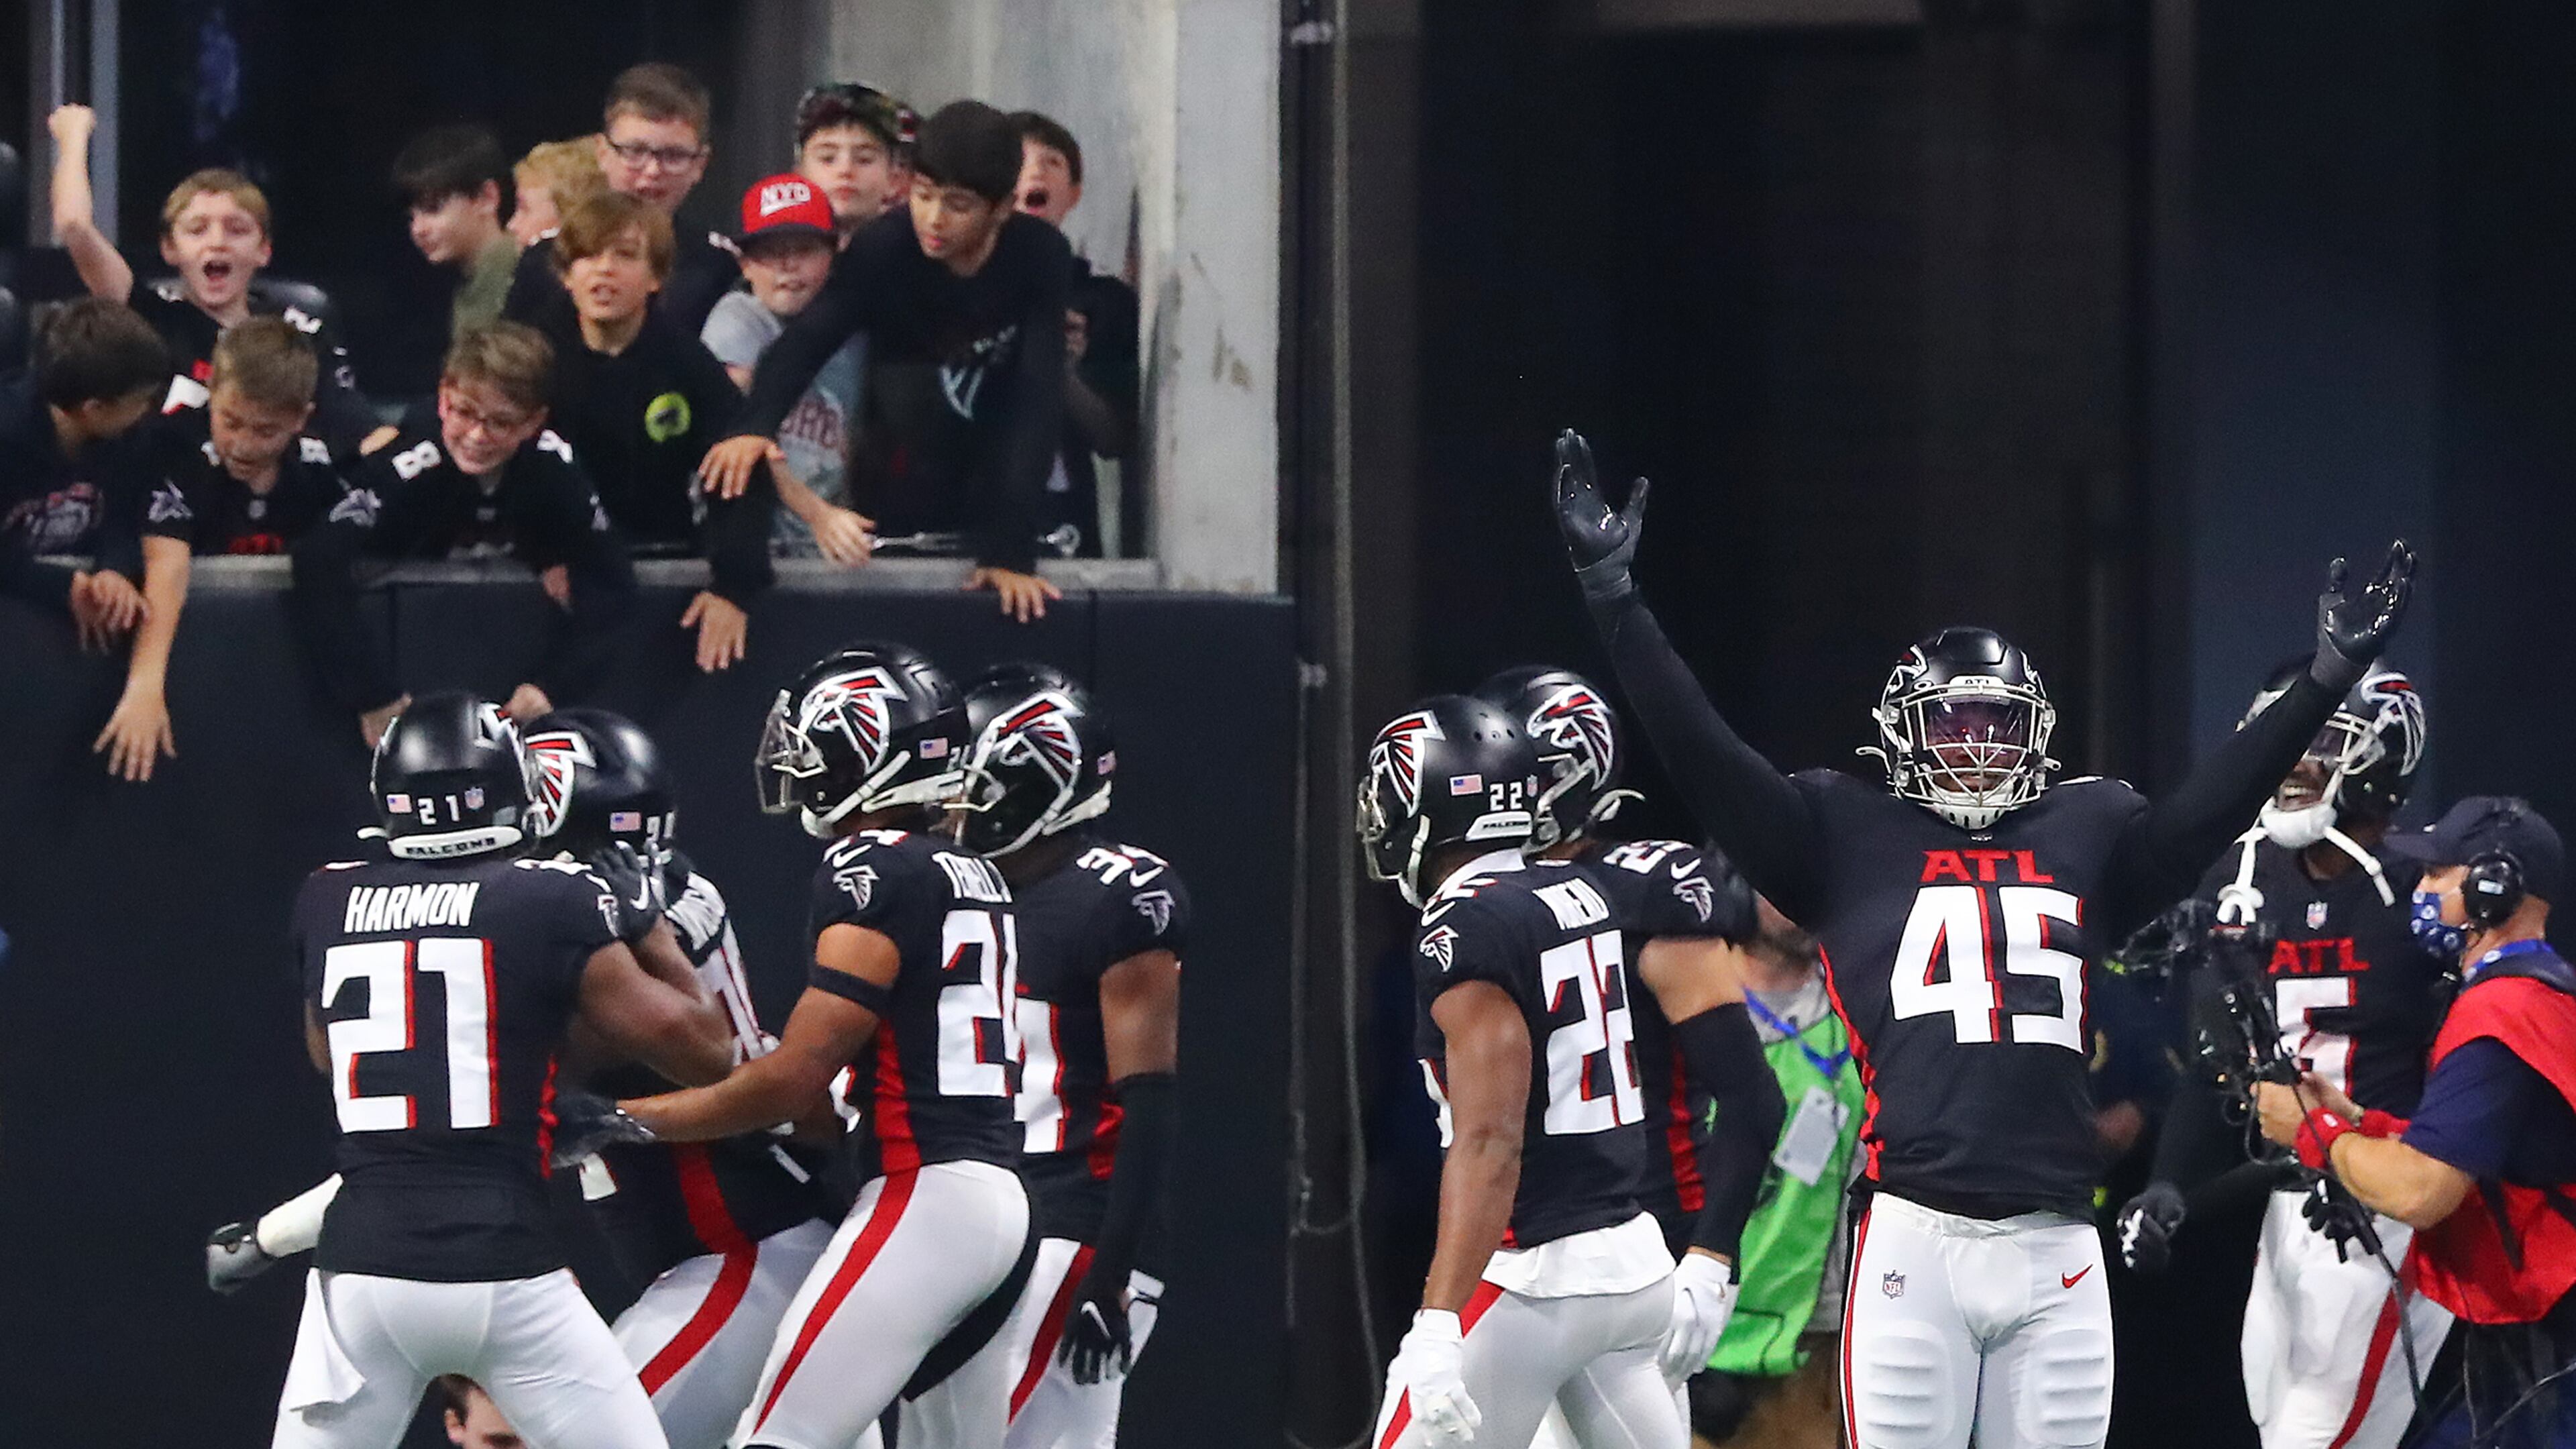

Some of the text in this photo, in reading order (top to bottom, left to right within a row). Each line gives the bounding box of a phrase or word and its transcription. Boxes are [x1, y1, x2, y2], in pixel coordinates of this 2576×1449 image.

[417, 794, 460, 826] 21
[1489, 781, 1523, 812] 22
[405, 837, 496, 855] FALCONS
[1920, 849, 2055, 883] ATL
[343, 881, 480, 934] HARMON
[1889, 884, 2088, 1055] 45
[2267, 936, 2370, 973] ATL
[322, 937, 499, 1134] 21
[1540, 929, 1646, 1135] 22
